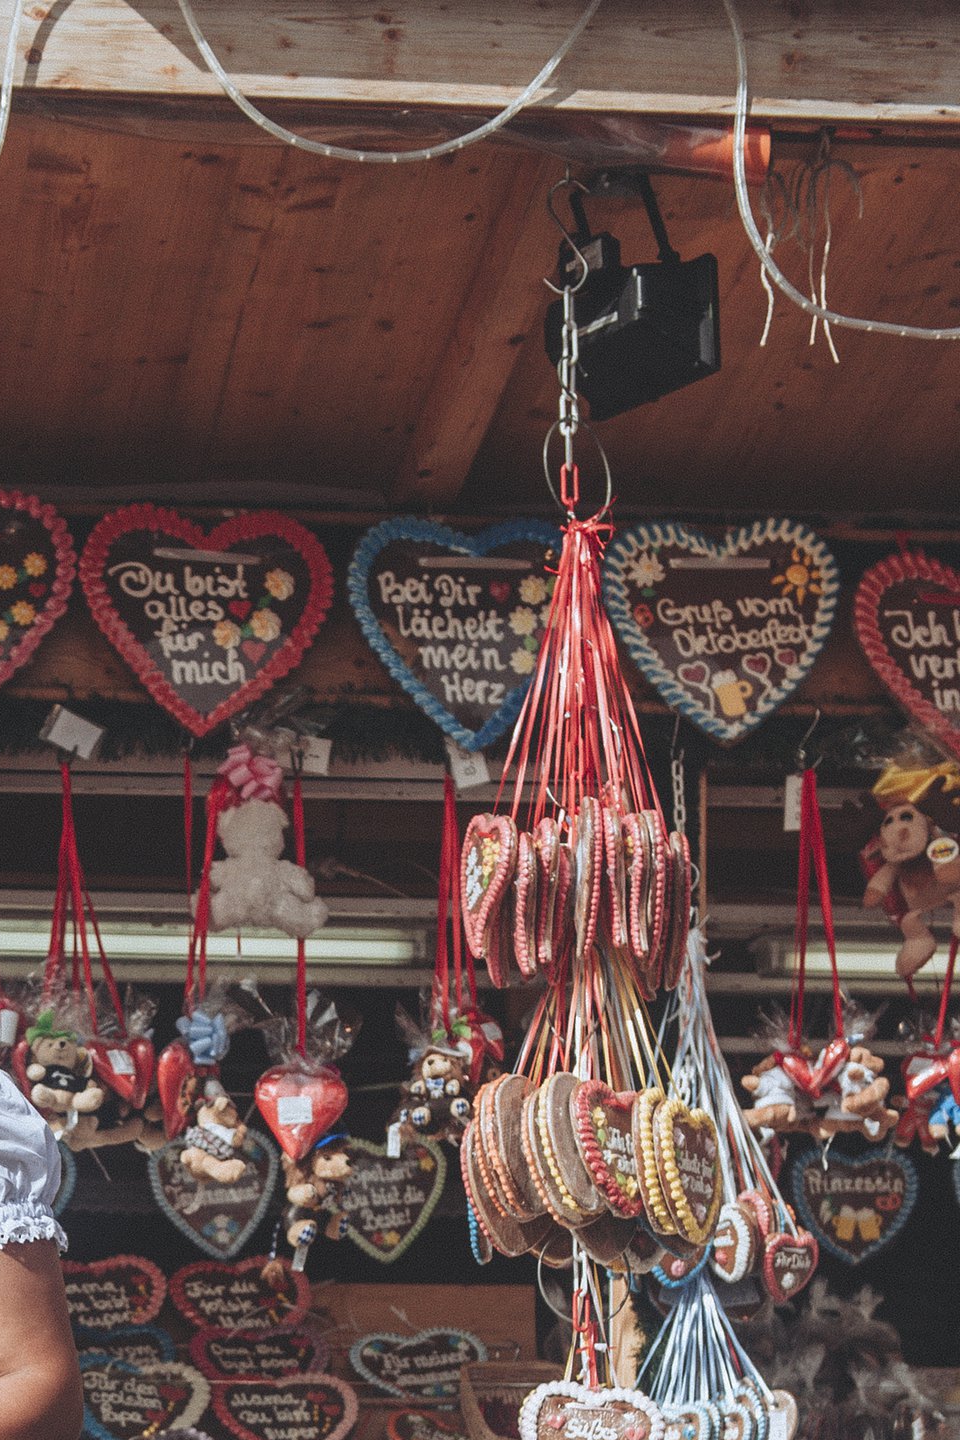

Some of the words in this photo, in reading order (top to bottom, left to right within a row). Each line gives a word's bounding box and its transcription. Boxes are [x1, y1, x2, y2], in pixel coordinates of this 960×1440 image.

[108, 561, 180, 598] Du
[183, 562, 249, 598] bist
[377, 571, 433, 604] Bei
[433, 574, 482, 607] Dir
[143, 595, 225, 621] alles
[396, 605, 505, 642] lächelt
[656, 598, 735, 629] Gruß
[735, 597, 800, 619] vom
[153, 620, 206, 659] für
[418, 641, 507, 671] mein
[672, 618, 813, 659] Oktoberfest
[171, 647, 246, 685] mich
[440, 671, 506, 705] Herz
[65, 1281, 127, 1300] ama,
[81, 1370, 118, 1390] Für
[122, 1377, 159, 1396] den
